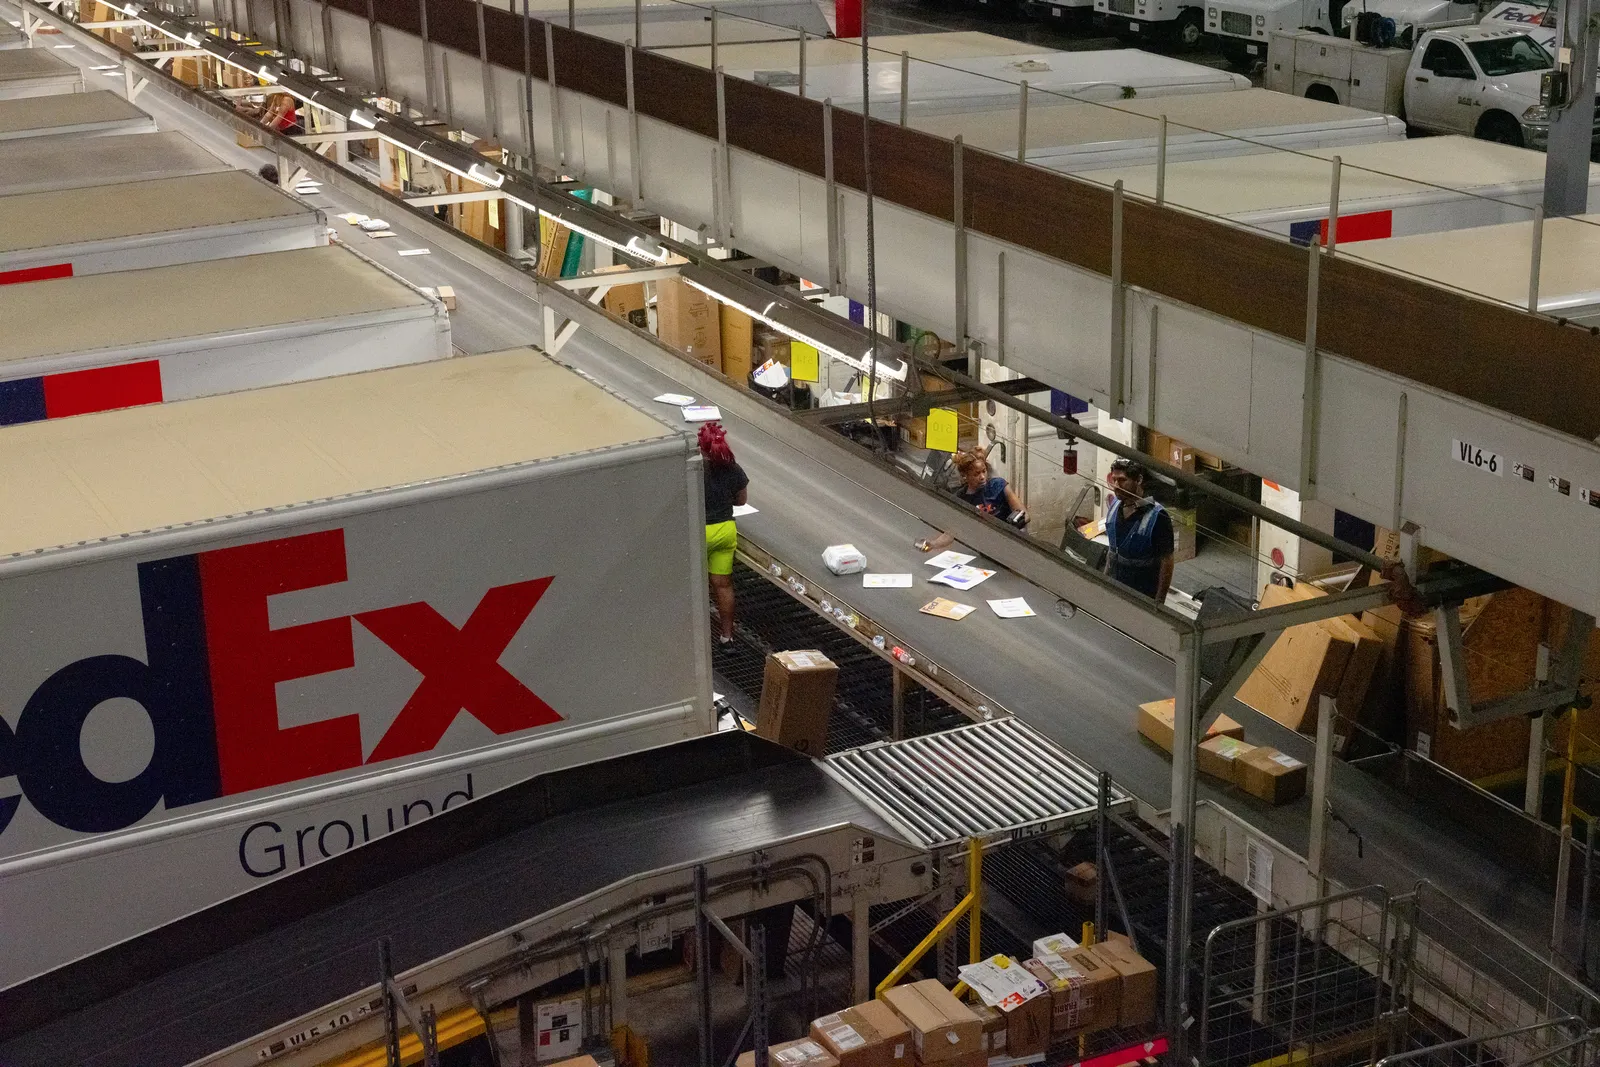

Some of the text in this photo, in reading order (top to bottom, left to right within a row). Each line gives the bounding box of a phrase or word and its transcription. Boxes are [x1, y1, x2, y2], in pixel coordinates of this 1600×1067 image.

[753, 361, 774, 379] FedEx
[1460, 441, 1497, 473] VL6-6
[0, 528, 566, 836] dEx
